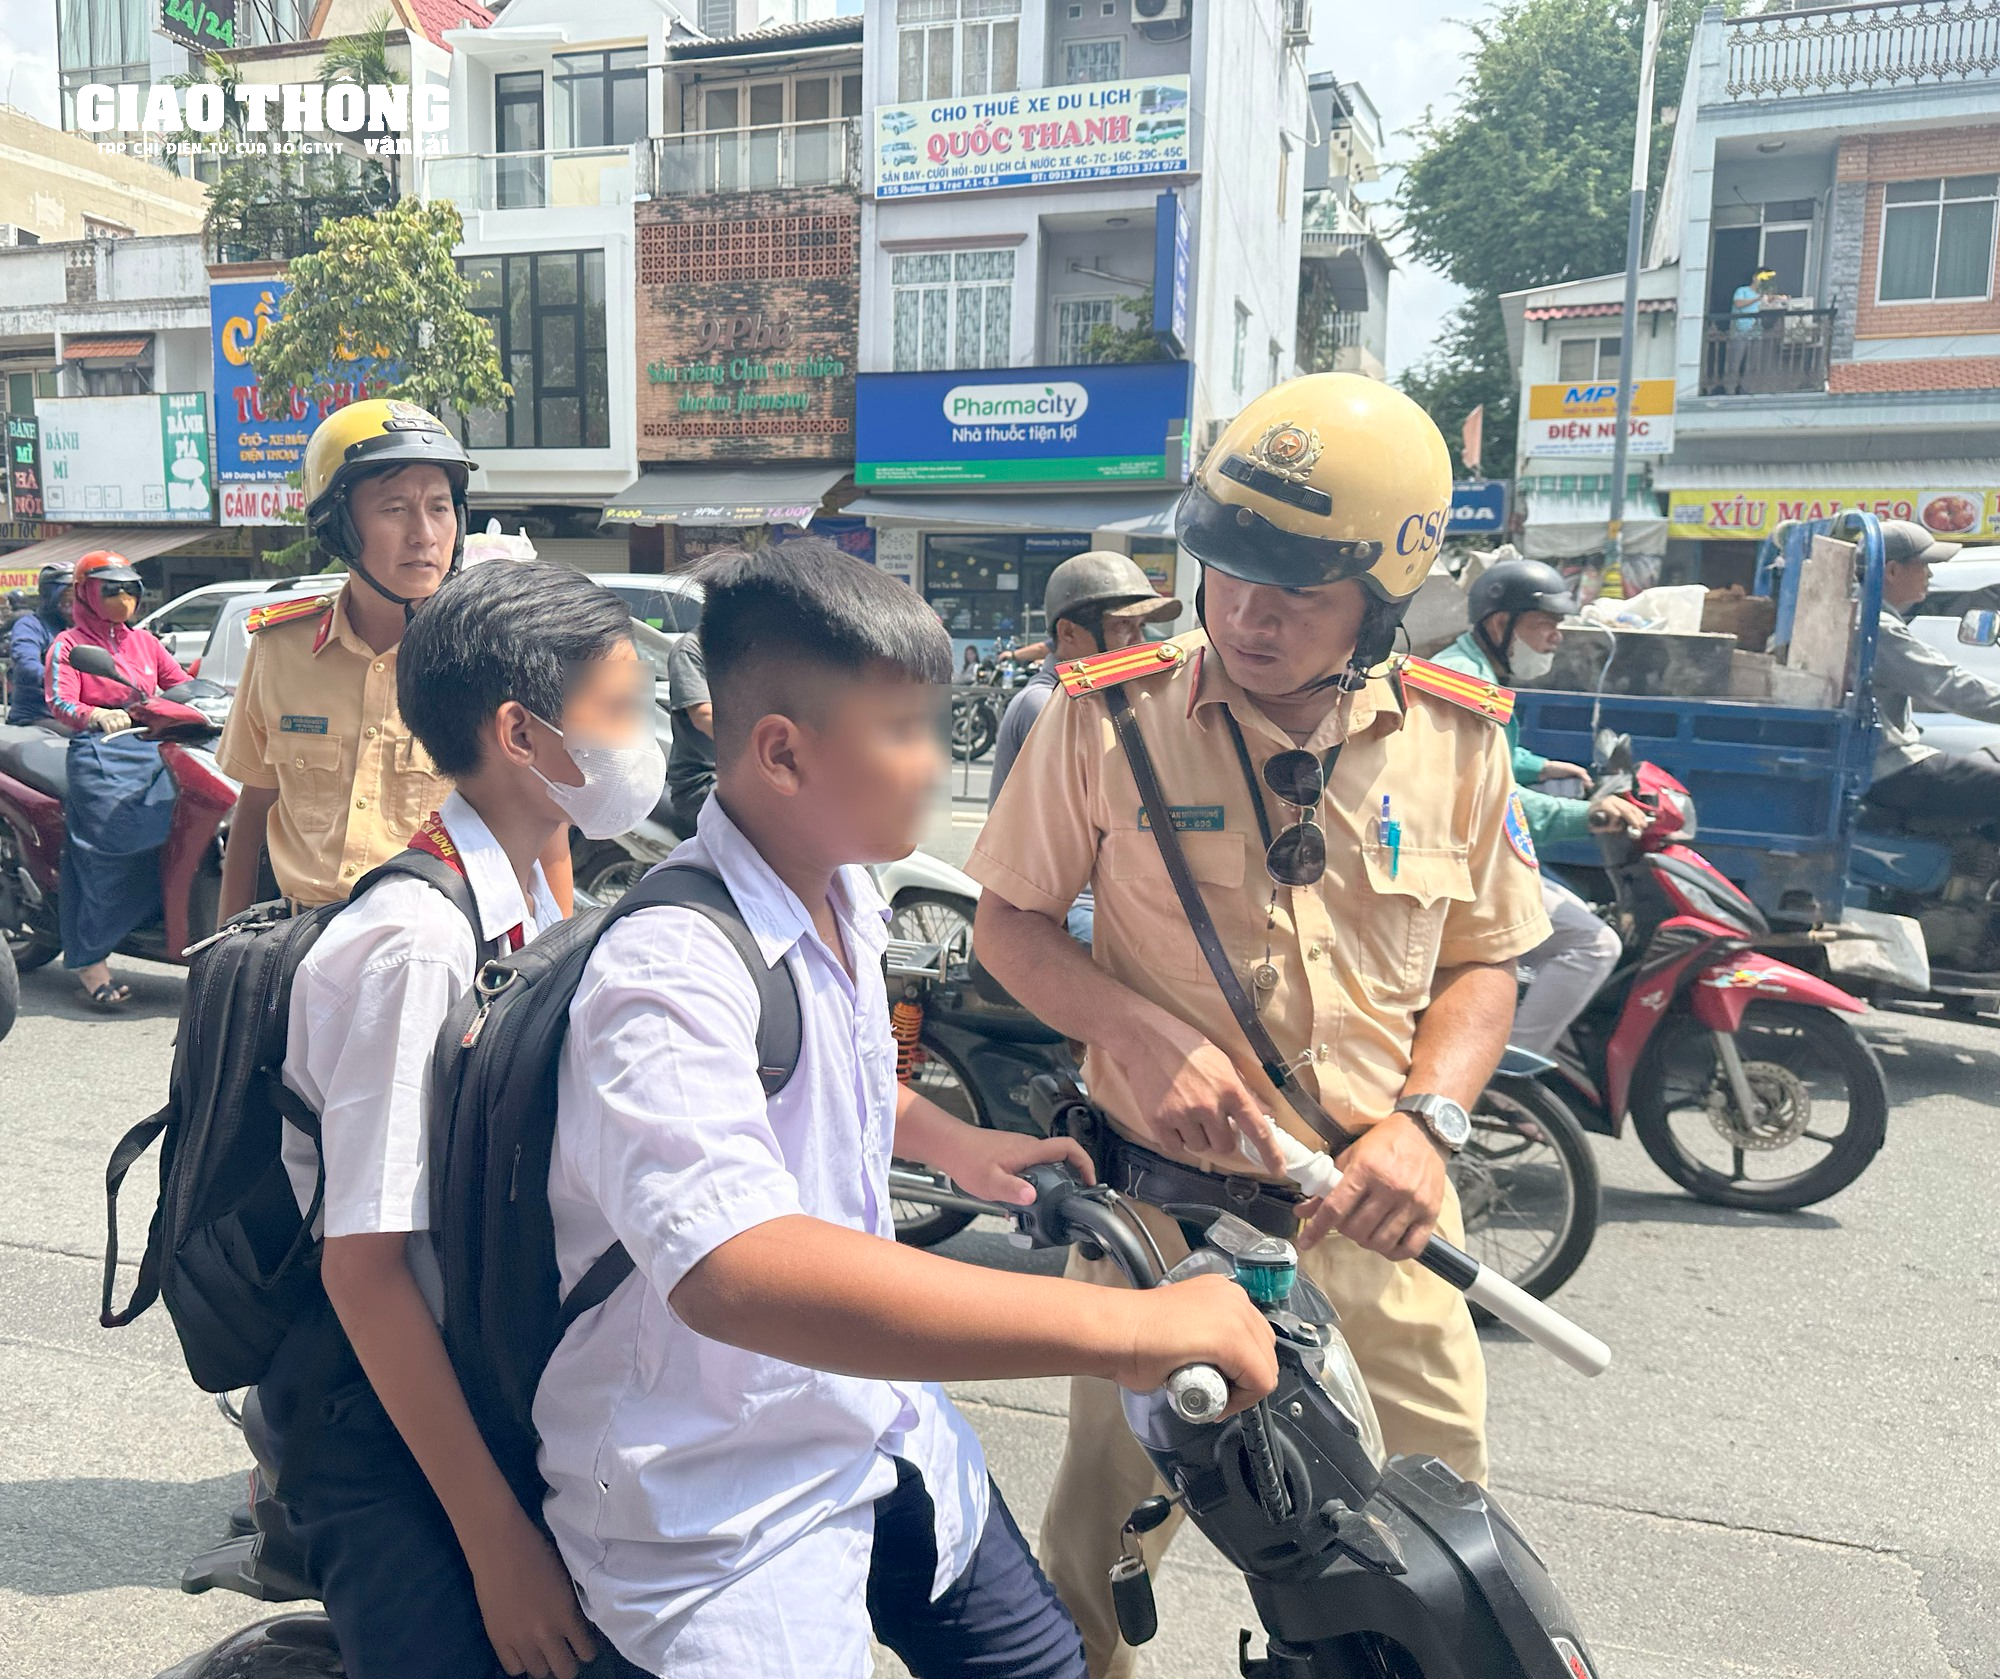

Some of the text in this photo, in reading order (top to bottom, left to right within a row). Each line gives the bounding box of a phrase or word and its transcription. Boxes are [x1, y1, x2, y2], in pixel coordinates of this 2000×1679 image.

[931, 89, 1130, 123] CHO THUÊ XE DU LỊCH
[927, 115, 1131, 165] QUỐC THANH
[990, 161, 1011, 175] LỊCH
[1030, 155, 1056, 169] NƯỚC
[1059, 156, 1071, 167] XE
[233, 375, 309, 424] TÙG
[678, 388, 811, 415] durian farmstay
[953, 389, 1077, 418] Pharmacity
[9, 418, 38, 439] BÁNH
[167, 410, 204, 434] BÁNH
[952, 423, 1078, 443] Nhà thuốc tiện lợi
[1548, 420, 1592, 440] ĐIỆN
[46, 427, 79, 450] BÁNH
[16, 442, 34, 464] MÌ
[240, 447, 264, 464] ĐIỆN
[15, 468, 38, 490] HÀ
[14, 494, 43, 518] NỘI
[225, 484, 256, 518] CẦM
[1708, 494, 1766, 527] XÍU
[428, 830, 457, 858] MINH
